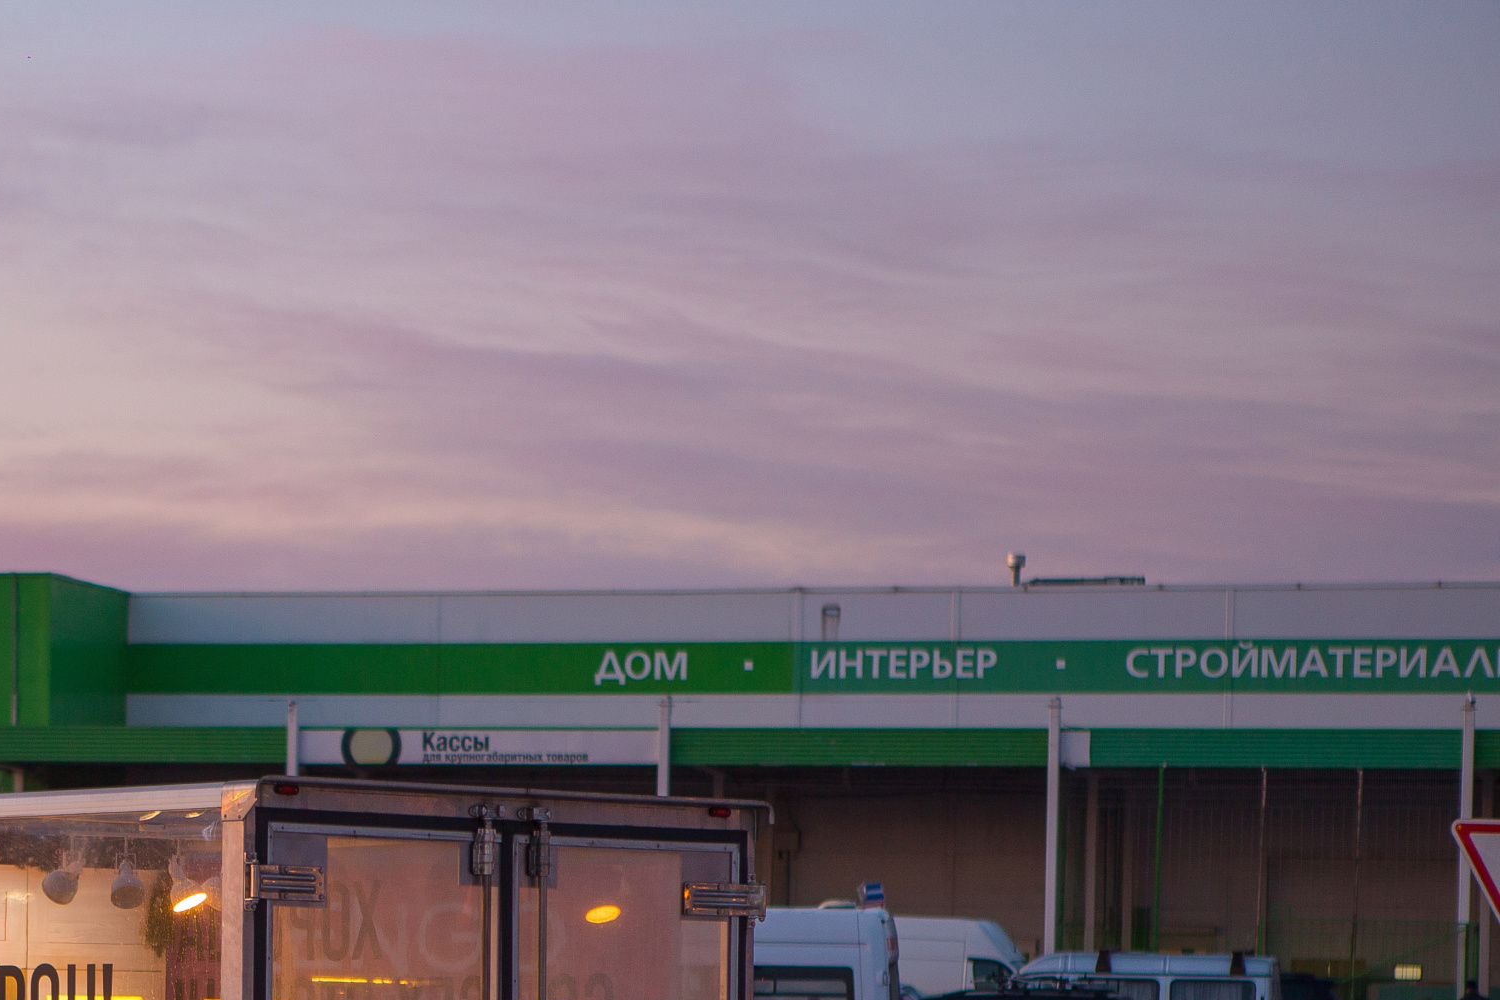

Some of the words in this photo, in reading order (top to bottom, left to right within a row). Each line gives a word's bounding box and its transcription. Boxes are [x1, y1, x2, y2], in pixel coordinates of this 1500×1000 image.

[594, 650, 688, 685] ДОМ
[810, 647, 997, 680] ИНТЕРЬЕР
[1125, 641, 1500, 678] СТРОЙМАТЕРИАЛ
[422, 731, 489, 751] Кассы
[422, 753, 441, 764] для
[445, 752, 542, 765] крупногабаритных
[546, 753, 589, 764] товаров
